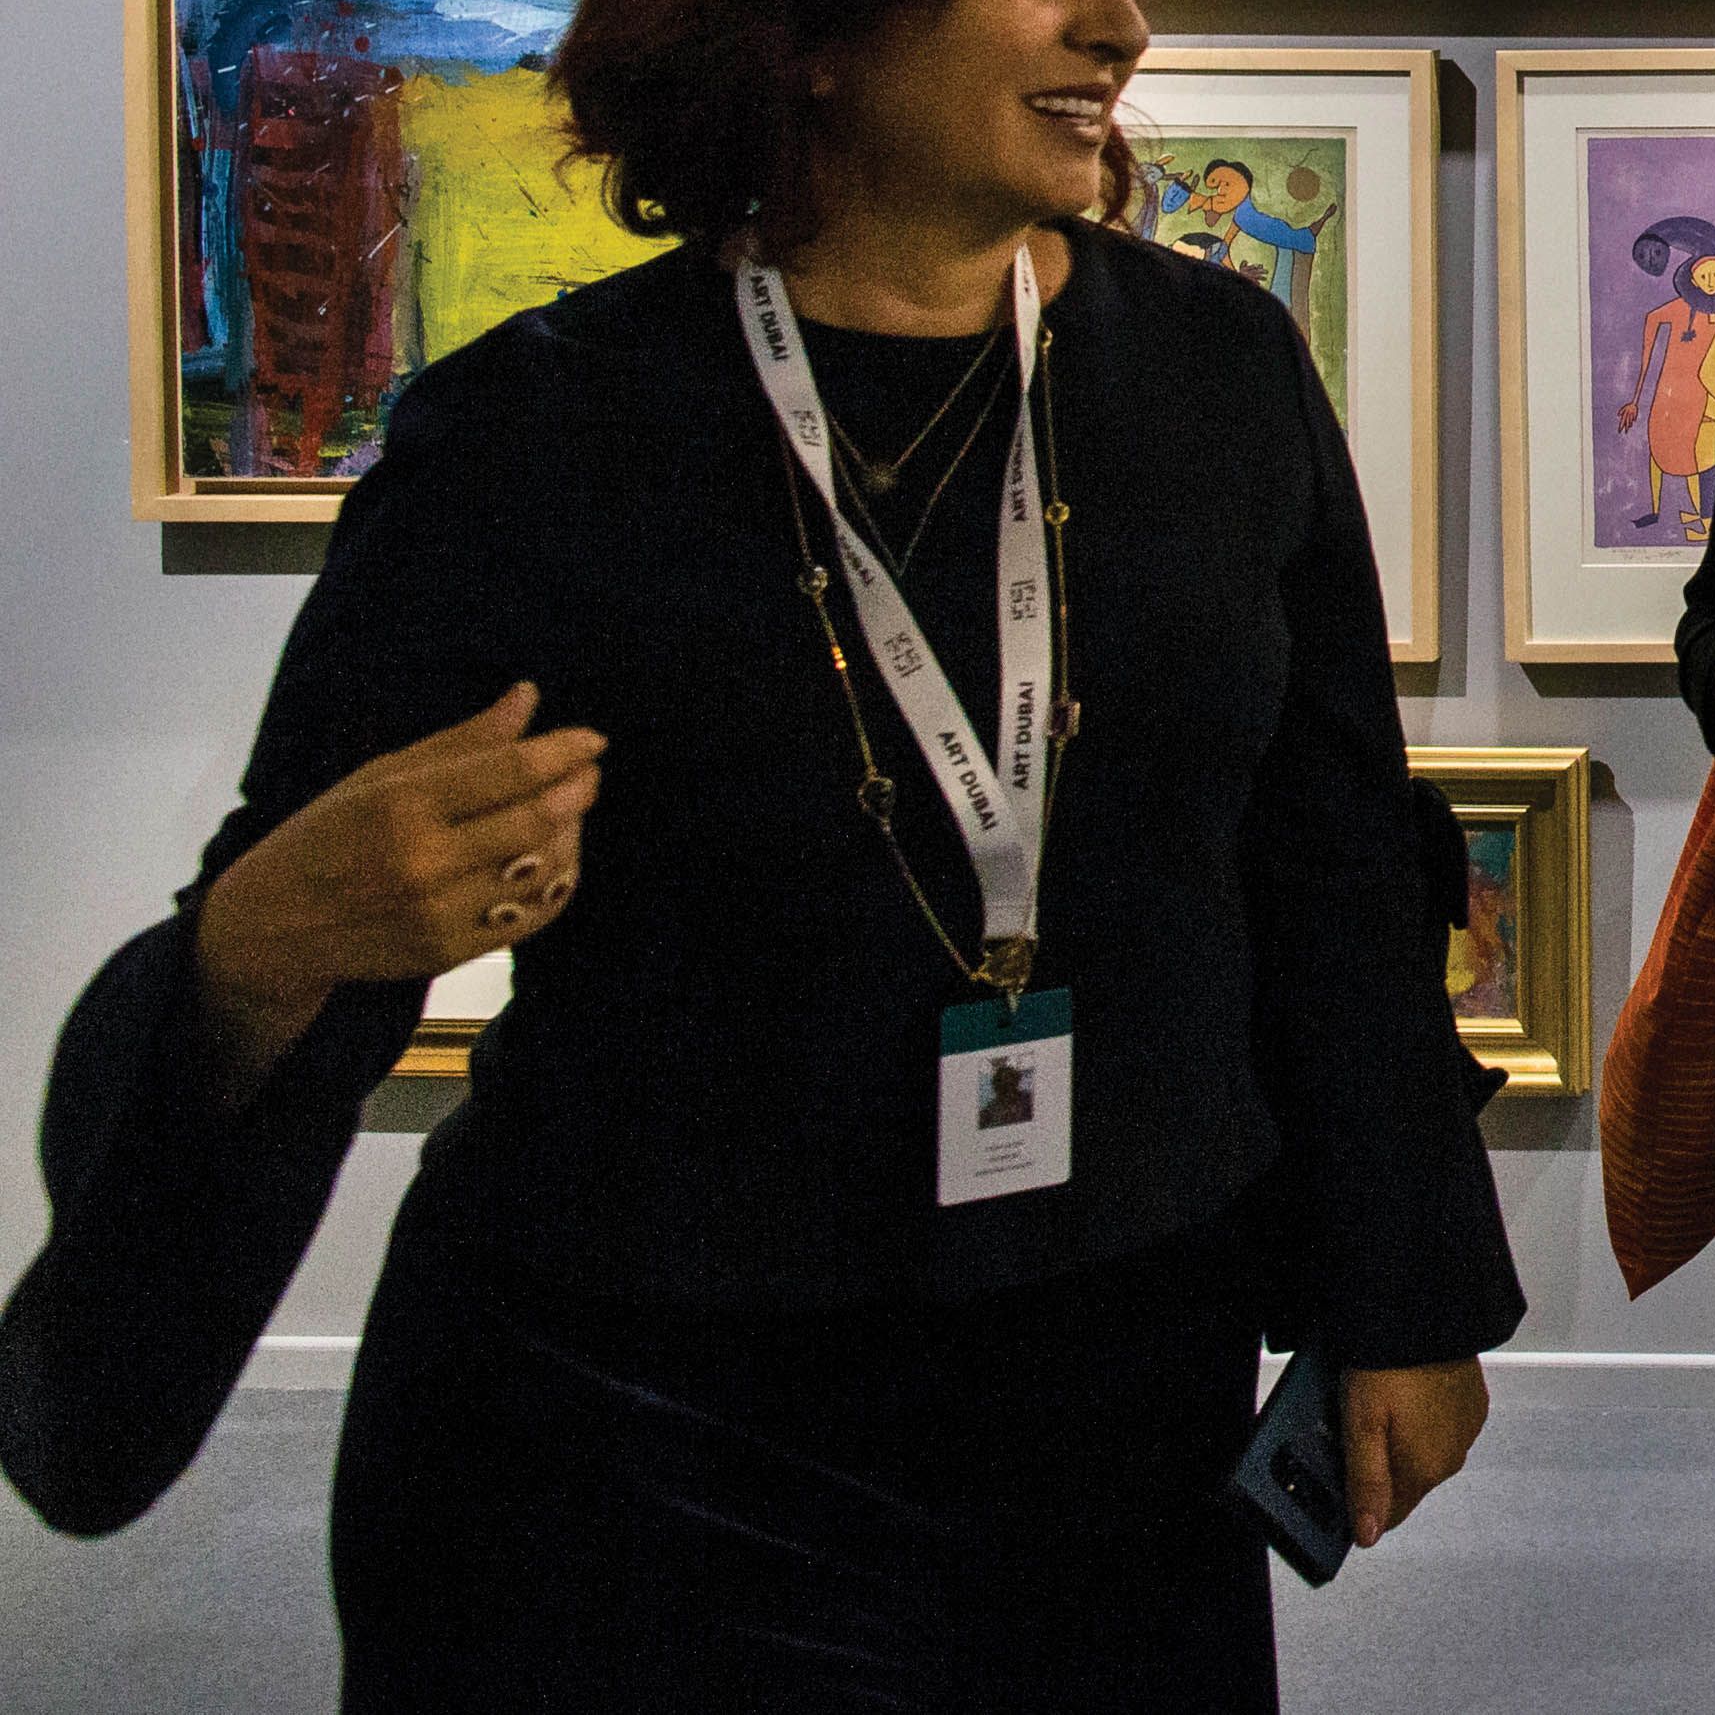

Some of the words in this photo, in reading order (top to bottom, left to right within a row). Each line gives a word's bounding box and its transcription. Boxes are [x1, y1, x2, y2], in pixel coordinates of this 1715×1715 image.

[749, 275, 773, 307] ART
[760, 309, 790, 363] DUBAI
[1015, 680, 1036, 747] DUBAI
[936, 730, 971, 768] ART
[959, 769, 1000, 832] DUBAI
[1012, 749, 1031, 791] ART
